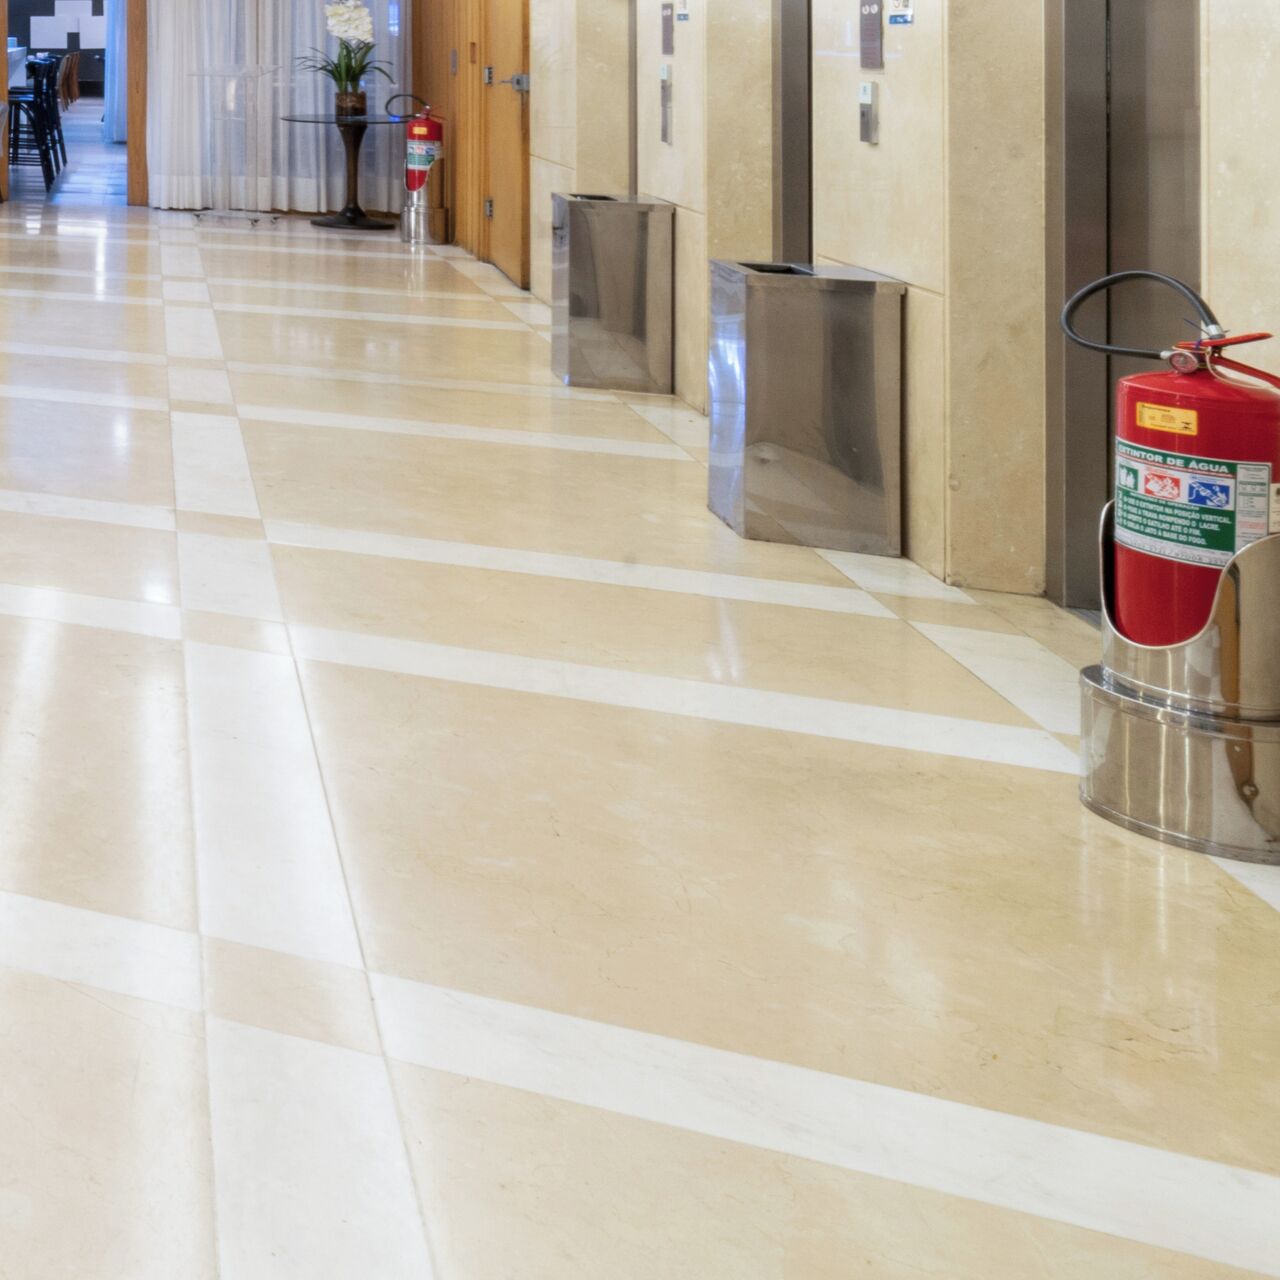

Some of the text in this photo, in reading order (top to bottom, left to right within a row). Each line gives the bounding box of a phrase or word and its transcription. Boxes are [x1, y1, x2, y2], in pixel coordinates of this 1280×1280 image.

[1119, 444, 1229, 473] EXTINTOR DE ÁGUA
